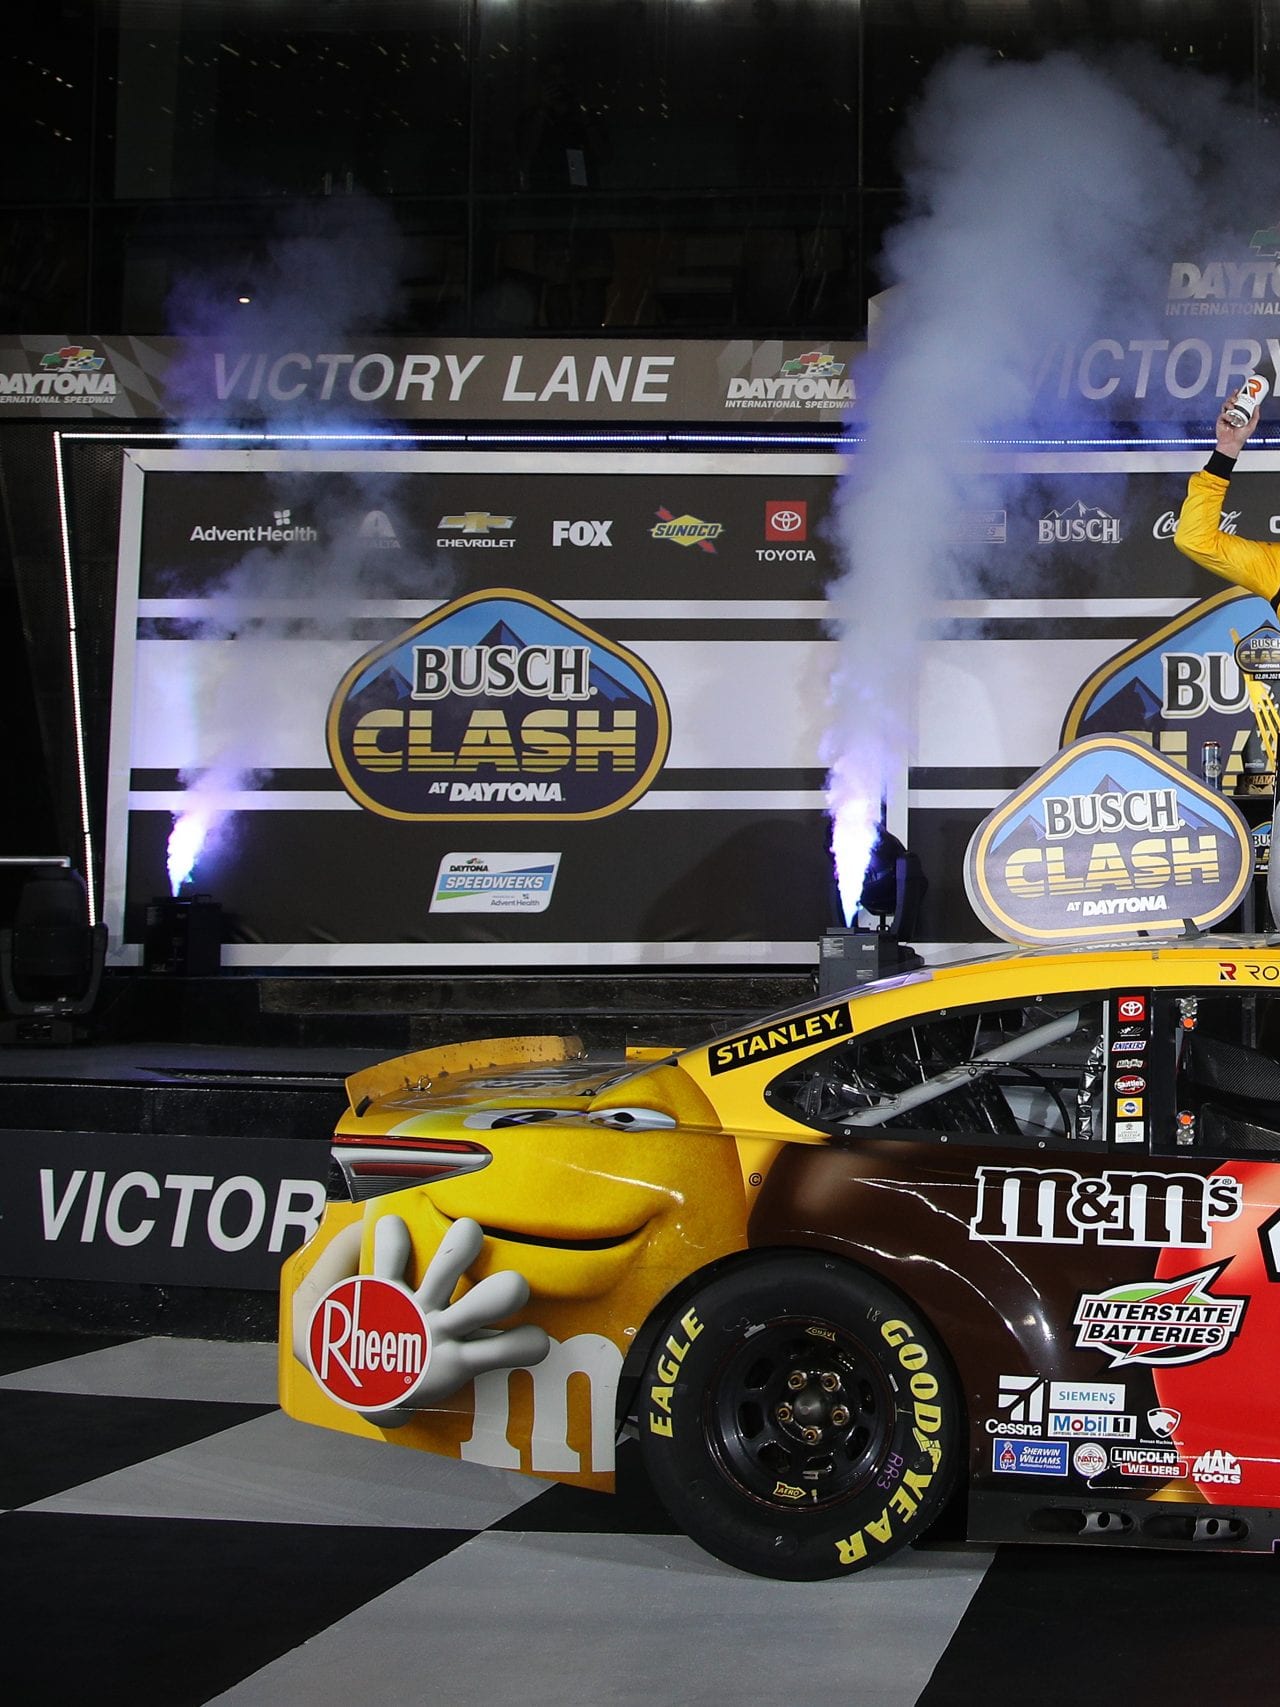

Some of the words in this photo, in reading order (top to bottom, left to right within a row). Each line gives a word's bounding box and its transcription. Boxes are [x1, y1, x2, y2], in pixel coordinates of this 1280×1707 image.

[213, 353, 485, 401] VICTORY
[502, 355, 675, 402] LANE
[726, 377, 857, 400] DAYTONA
[64, 395, 115, 404] SPEEDWAY
[725, 400, 802, 409] INTERNATIONAL
[805, 400, 857, 409] SPEEDWAY
[190, 523, 318, 543] AdventHealth
[552, 520, 614, 547] FOX
[652, 522, 723, 539] SUNOCO
[1038, 518, 1121, 544] BUSCH
[436, 538, 516, 548] CHEVROLET
[755, 549, 816, 562] TOYOTA
[412, 645, 592, 700] BUSCH
[353, 708, 637, 773] CLASH
[429, 782, 449, 794] AT
[449, 782, 563, 802] DAYTONA
[1043, 788, 1179, 840] BUSCH
[449, 864, 489, 872] DAYTONA
[1005, 835, 1219, 898] CLASH
[445, 876, 544, 889] SPEEDWEEKS
[1066, 902, 1082, 912] AT
[1082, 895, 1167, 916] DAYTONA
[717, 1009, 840, 1065] STANLEY
[40, 1168, 327, 1253] VICTOR
[1085, 1301, 1232, 1324] INTERSTATE
[320, 1281, 422, 1388] Rheem
[1087, 1324, 1224, 1344] BATTERIES
[650, 1306, 704, 1438] EAGLE
[1058, 1390, 1116, 1402] SIEMENS
[985, 1419, 1042, 1436] Cessna
[1053, 1415, 1107, 1432] Mobil
[834, 1319, 942, 1565] GOODYEAR
[1022, 1446, 1060, 1456] SHERWIN
[1019, 1454, 1060, 1465] WILLIAMS
[1115, 1449, 1175, 1464] LINCOLN
[1192, 1449, 1241, 1474] MAC
[1128, 1463, 1180, 1475] WELDERS
[1192, 1473, 1241, 1484] TOOLS
[778, 1486, 799, 1497] AERO
